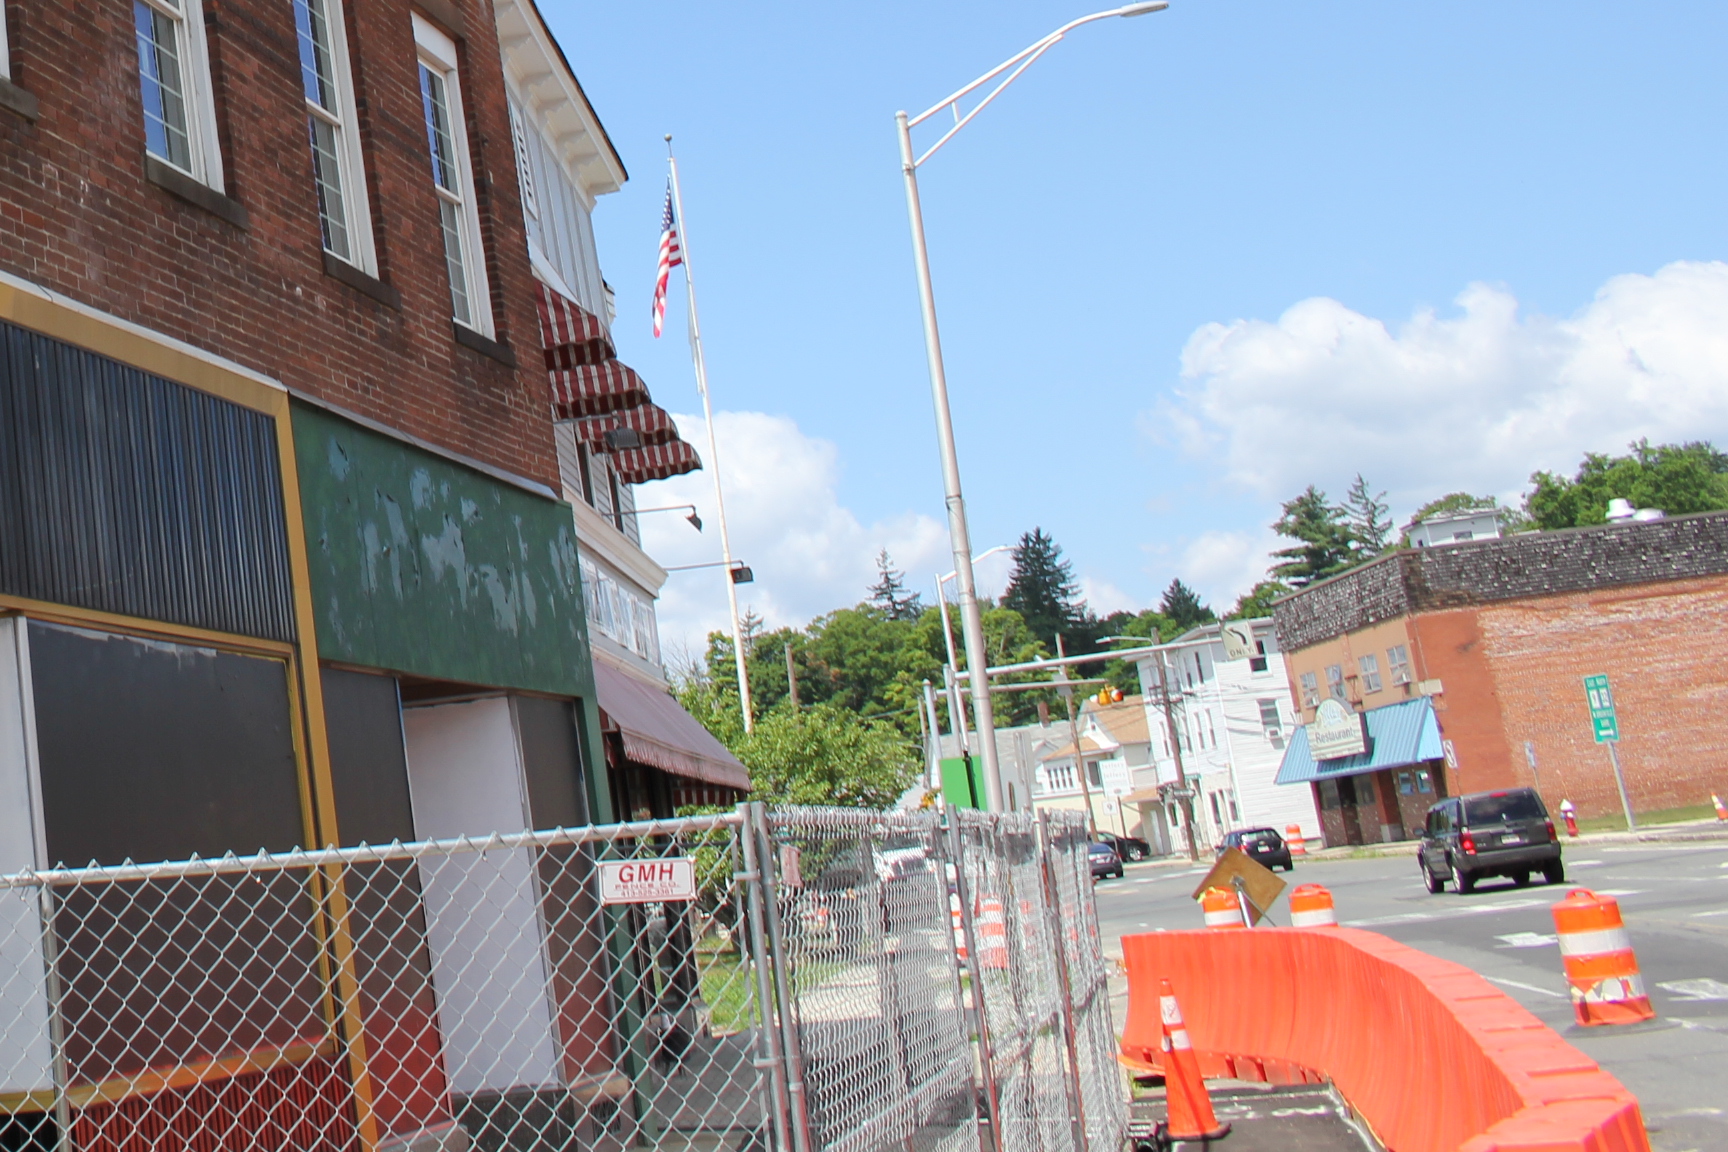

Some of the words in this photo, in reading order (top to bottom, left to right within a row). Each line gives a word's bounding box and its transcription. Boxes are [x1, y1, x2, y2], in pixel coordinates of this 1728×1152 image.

[1229, 647, 1254, 656] ONLY
[1315, 727, 1354, 744] Restaurant
[619, 863, 674, 883] GMH
[615, 882, 654, 890] FENCE
